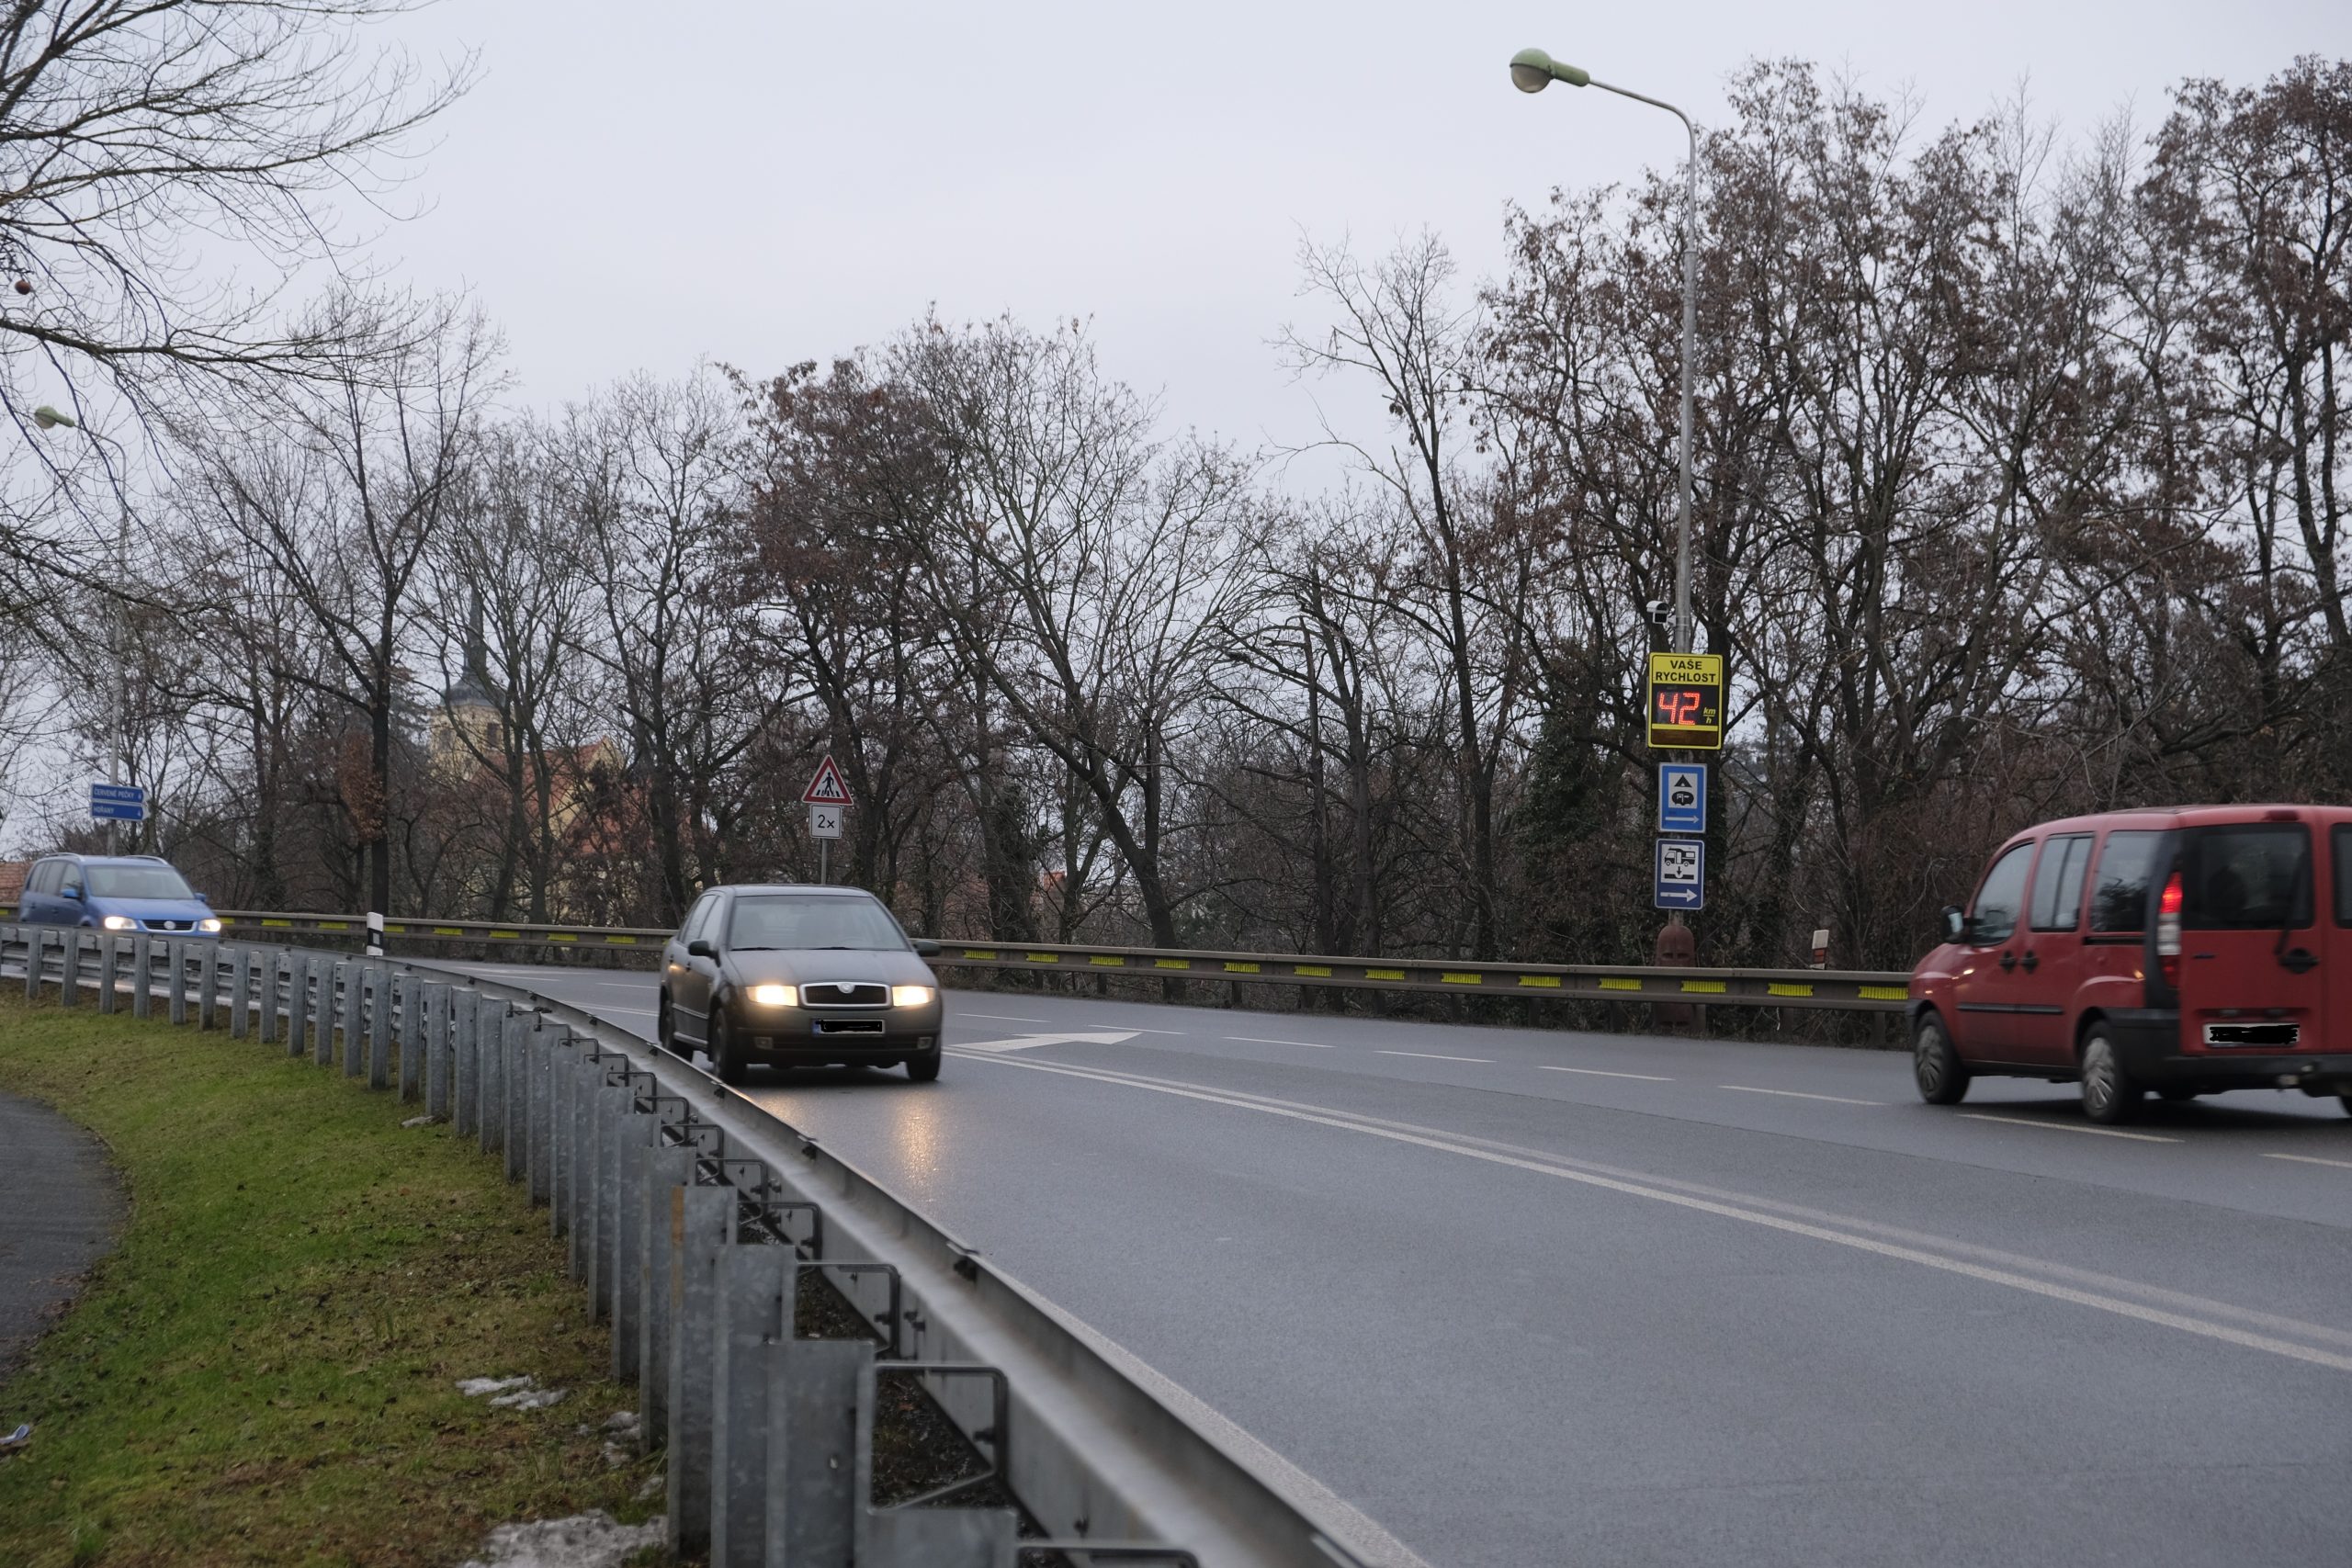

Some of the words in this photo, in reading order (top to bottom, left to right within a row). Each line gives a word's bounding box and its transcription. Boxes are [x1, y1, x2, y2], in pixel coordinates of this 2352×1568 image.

[1670, 659, 1702, 671] VAŠE
[1656, 671, 1716, 683] RYCHLOST
[1658, 692, 1700, 726] 42
[1702, 706, 1716, 715] km
[817, 814, 835, 829] 2x
